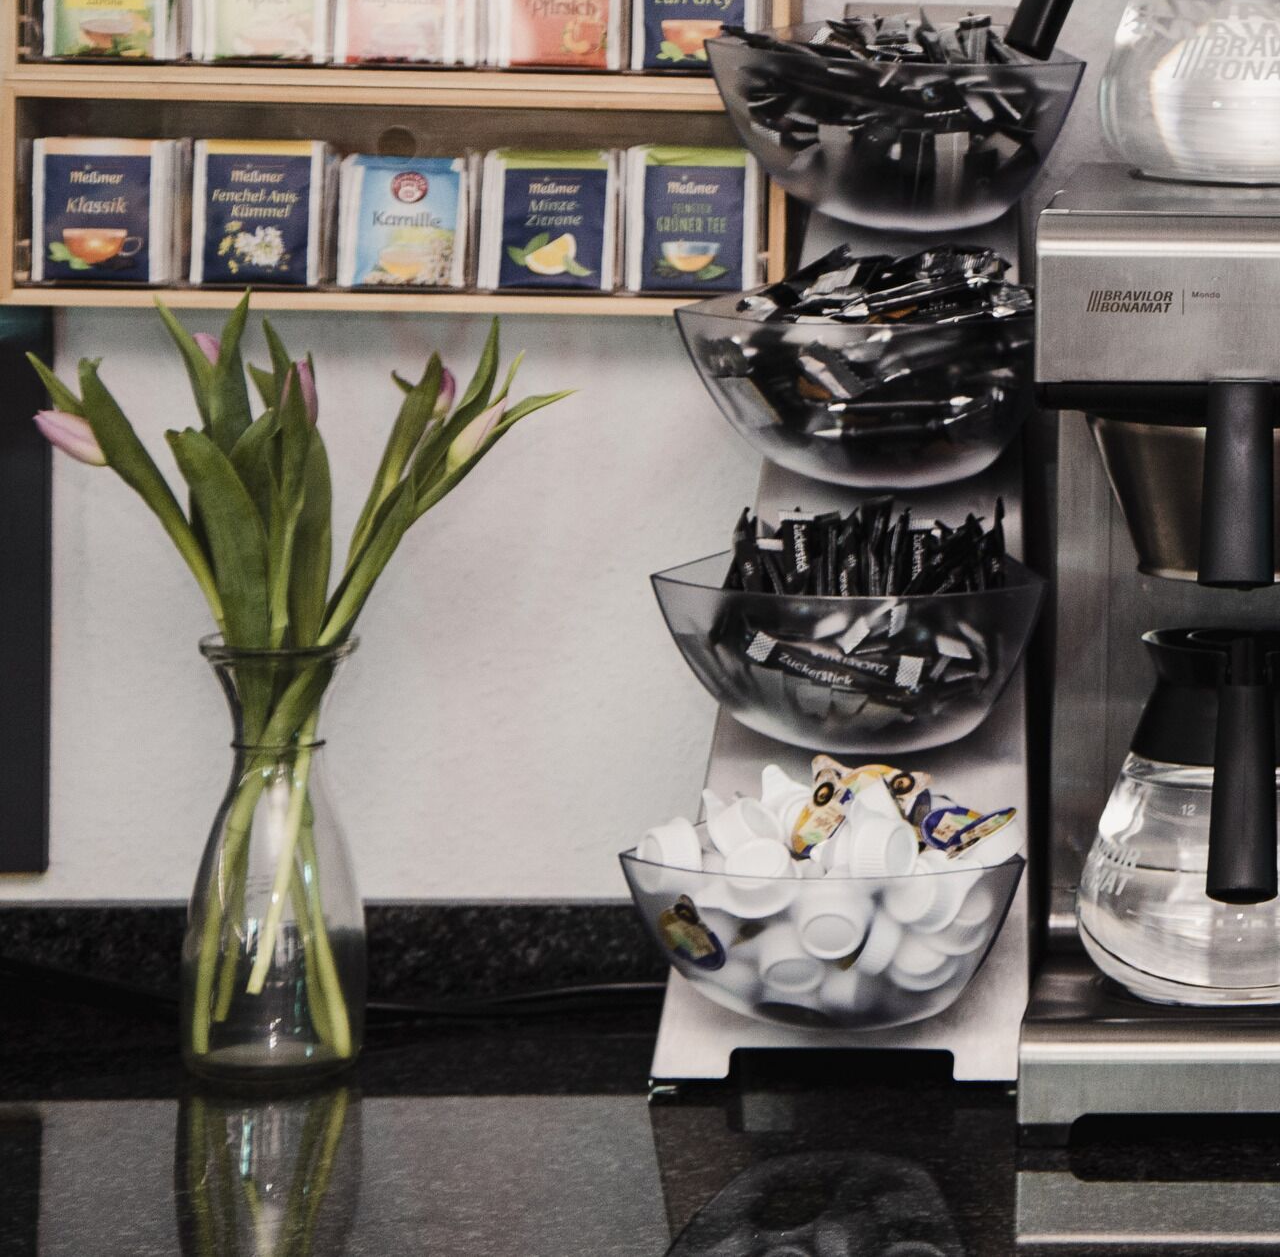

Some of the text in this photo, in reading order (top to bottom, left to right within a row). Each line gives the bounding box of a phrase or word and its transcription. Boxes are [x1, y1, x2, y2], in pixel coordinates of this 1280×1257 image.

[66, 196, 127, 214] Klassik
[230, 204, 292, 218] Kümmel
[372, 211, 442, 228] Kamille
[707, 217, 728, 233] TEE
[1103, 290, 1174, 302] BRAVILOR
[1100, 302, 1172, 313] BONAMAT
[778, 652, 854, 687] Zuckerstick
[1180, 804, 1197, 817] 12
